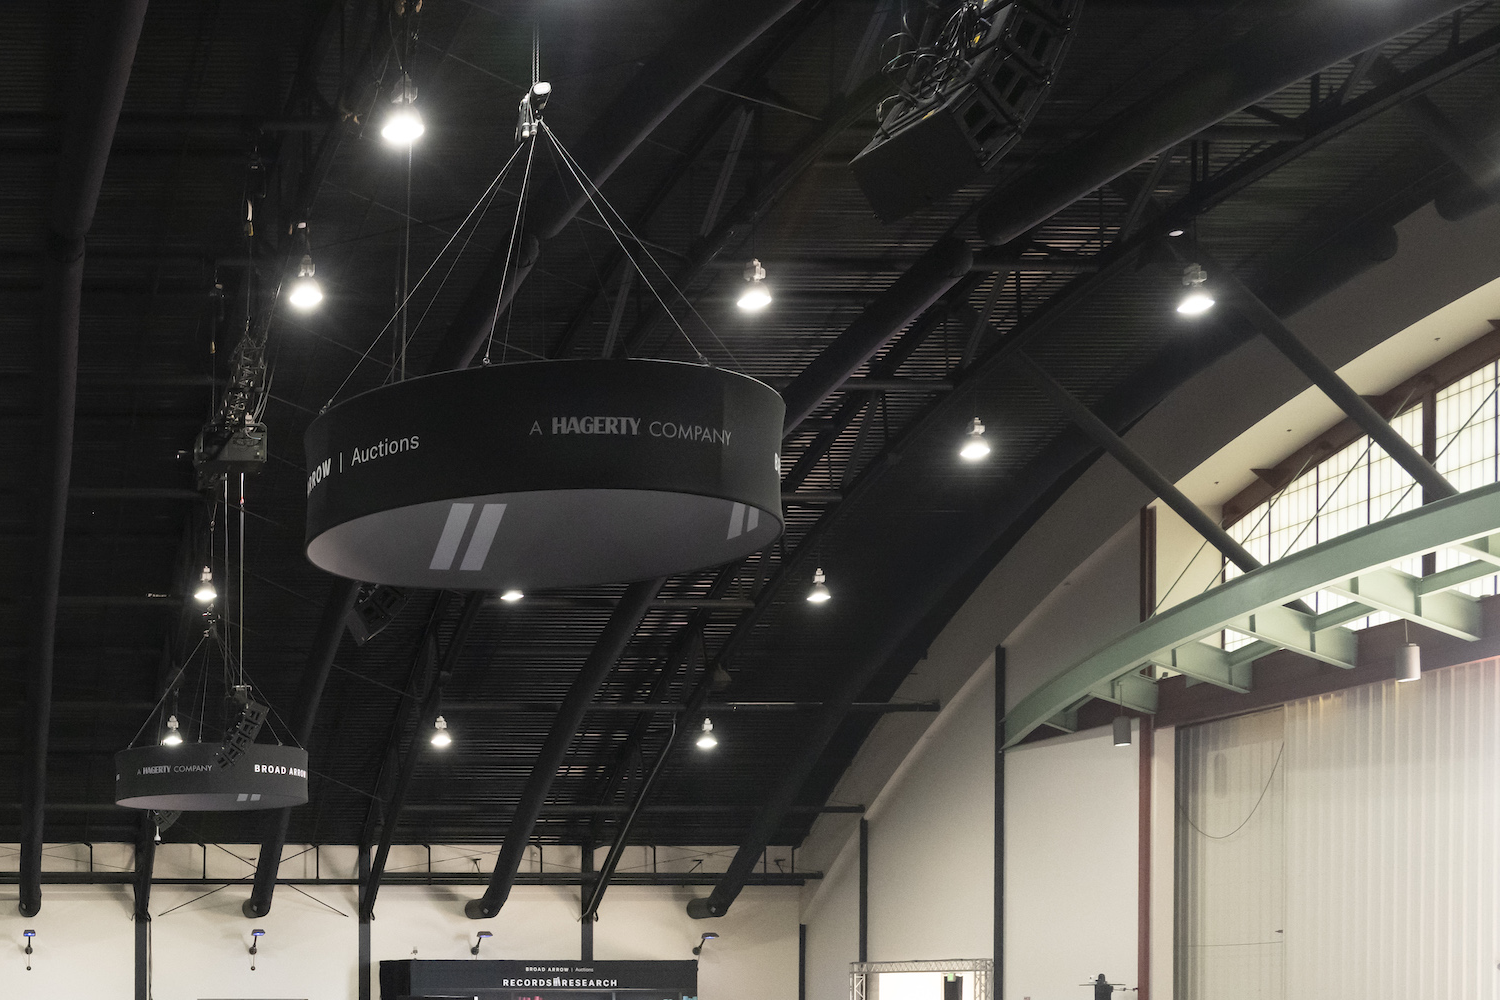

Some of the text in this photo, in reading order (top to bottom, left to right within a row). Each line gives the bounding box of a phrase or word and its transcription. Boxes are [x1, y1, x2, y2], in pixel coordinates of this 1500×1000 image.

[529, 416, 732, 446] A HAGERTY COMPANY
[351, 435, 420, 467] Auctions
[143, 764, 171, 775] HAGERTY
[173, 764, 213, 774] COMPANY
[254, 763, 287, 776] BROAD
[525, 965, 546, 973] BROAD
[502, 979, 618, 987] RECORDS RESEARCH
